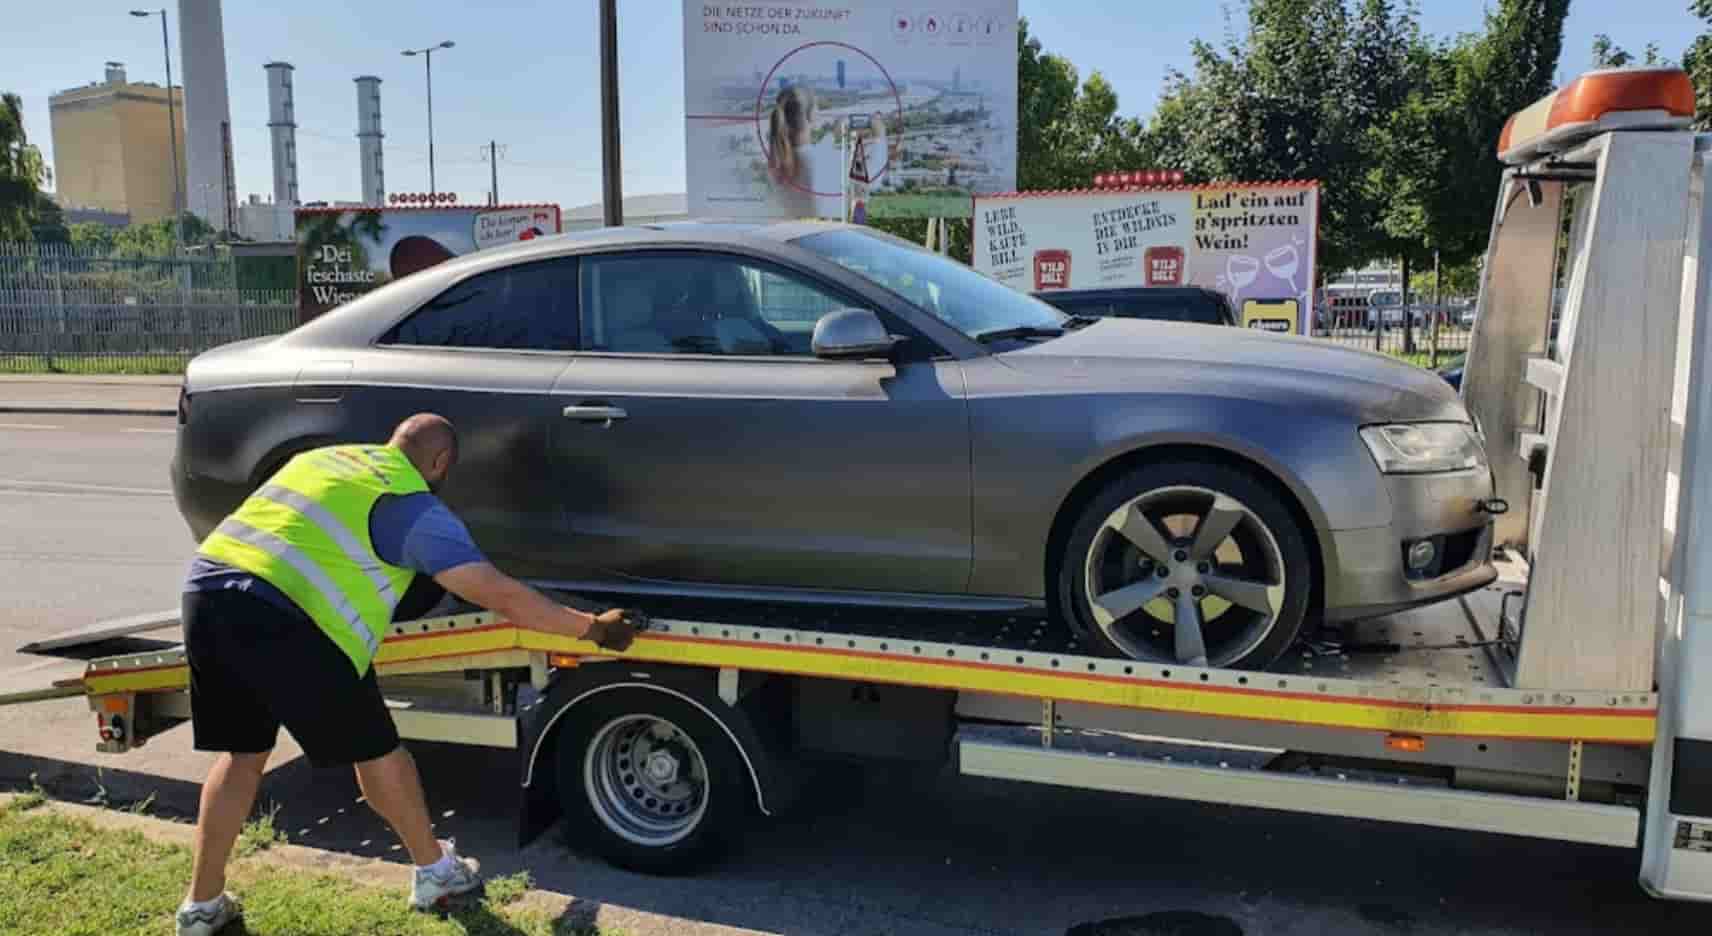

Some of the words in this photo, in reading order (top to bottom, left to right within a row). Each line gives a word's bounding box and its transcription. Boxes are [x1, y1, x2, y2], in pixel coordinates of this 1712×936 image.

[1241, 192, 1269, 208] ein
[1274, 191, 1308, 207] auf
[1095, 225, 1119, 241] DIE
[1195, 233, 1249, 249] Wein!
